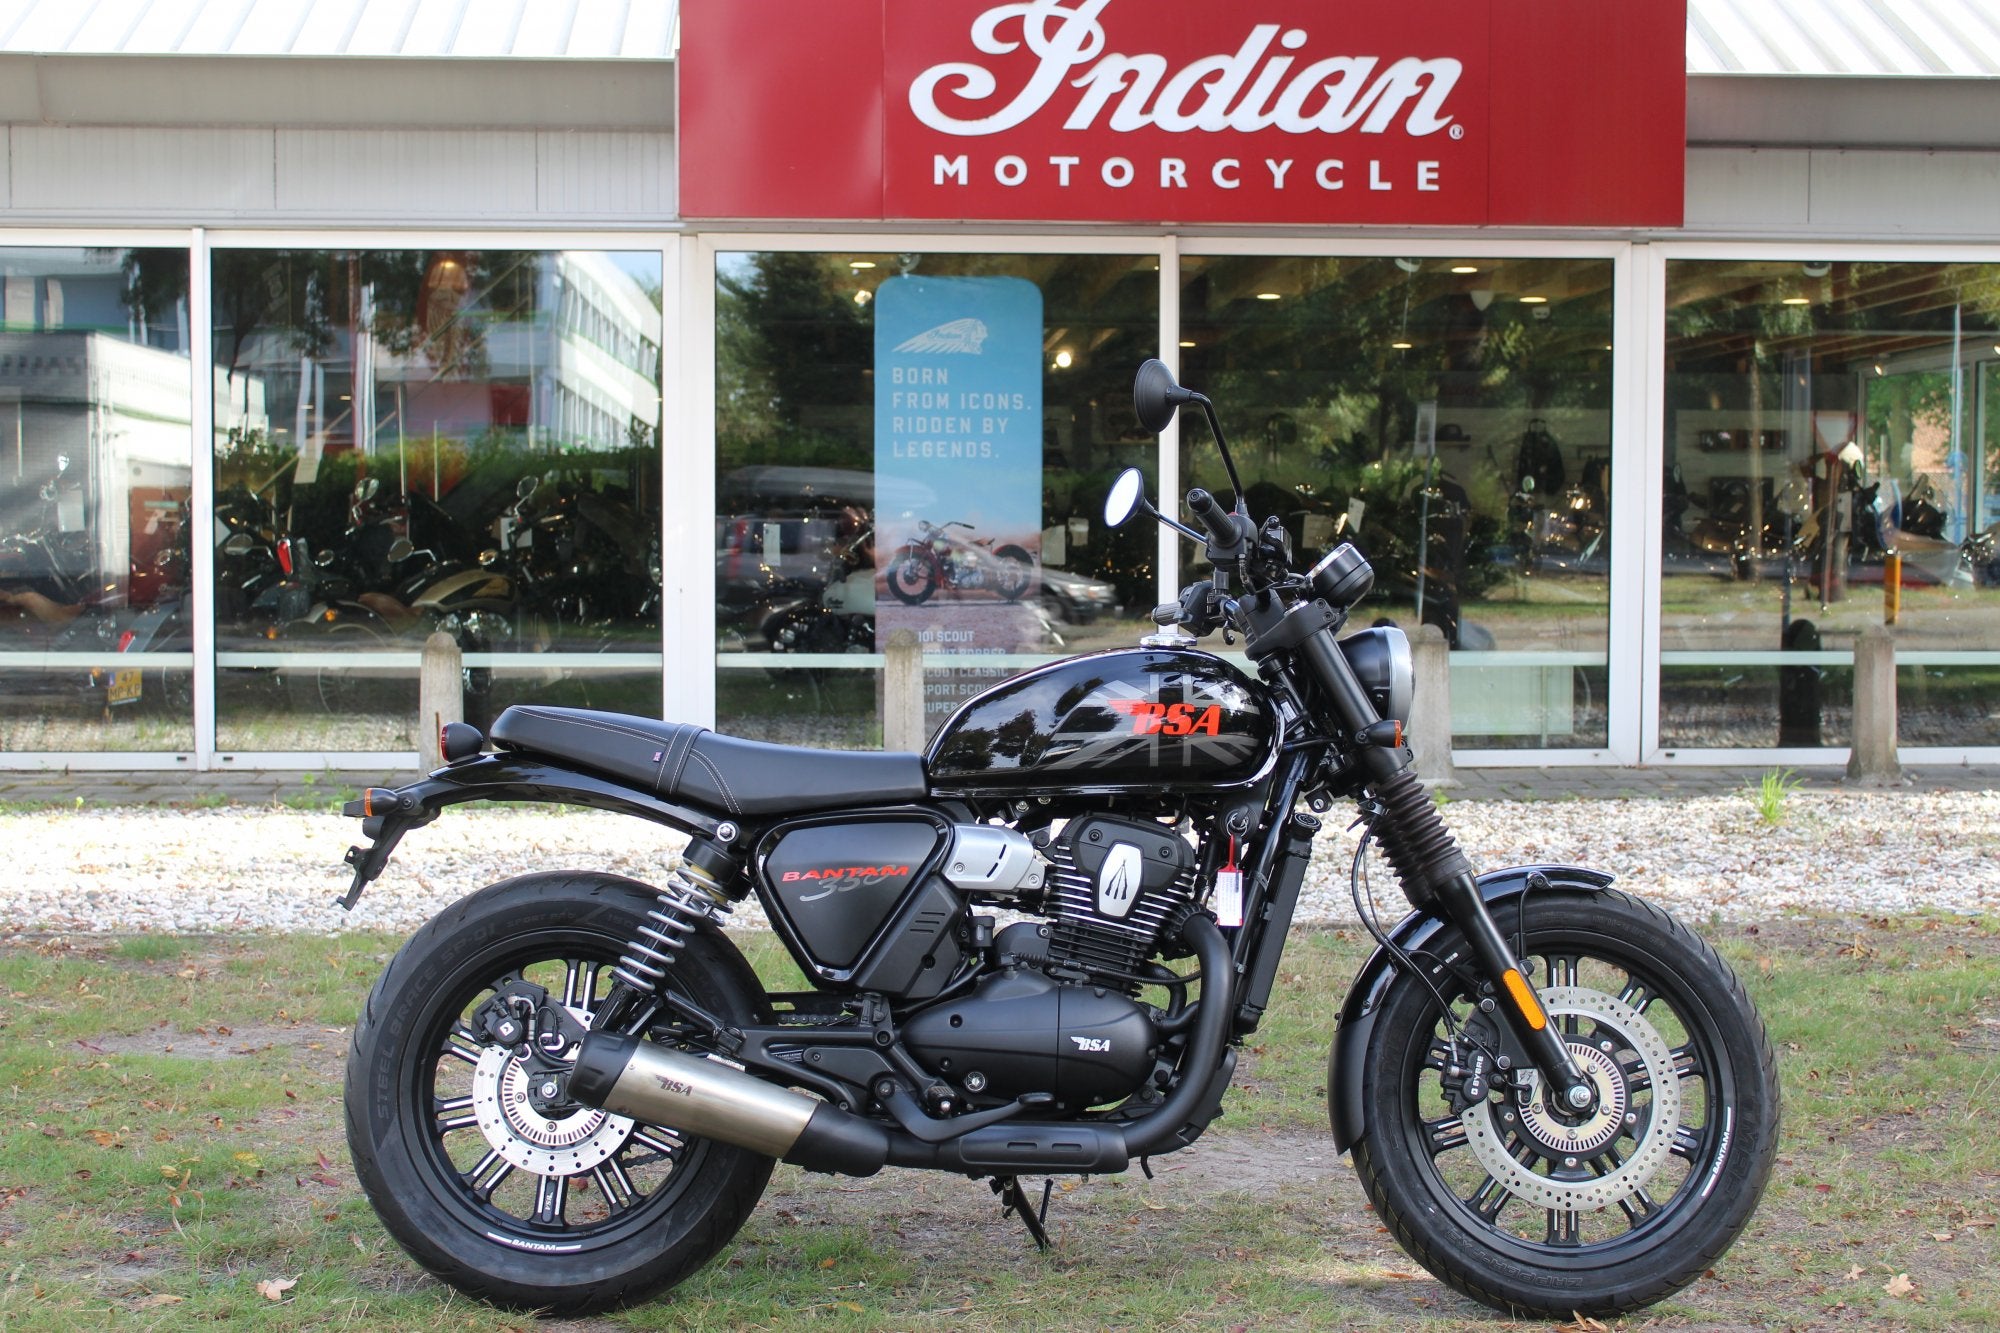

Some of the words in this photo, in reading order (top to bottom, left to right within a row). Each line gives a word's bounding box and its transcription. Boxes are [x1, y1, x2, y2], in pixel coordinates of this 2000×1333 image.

[909, 0, 1463, 136] Indian
[933, 153, 1440, 191] MOTORCYCLE
[892, 367, 949, 384] BORN
[892, 392, 949, 409] FROM
[960, 392, 1032, 410] ICONS.
[892, 416, 971, 434] RIDDEN
[982, 417, 1009, 434] BY
[893, 441, 1000, 459] LEGENDS.
[937, 630, 975, 642] SCOUT
[1108, 699, 1221, 737] BSA
[782, 865, 910, 882] BANTAM
[800, 864, 897, 902] 350
[1071, 1036, 1111, 1052] BSA
[1472, 1055, 1484, 1087] BYBRE
[656, 1075, 693, 1097] BSA
[1712, 1131, 1730, 1174] BANTAM
[511, 1239, 557, 1251] BANTAM
